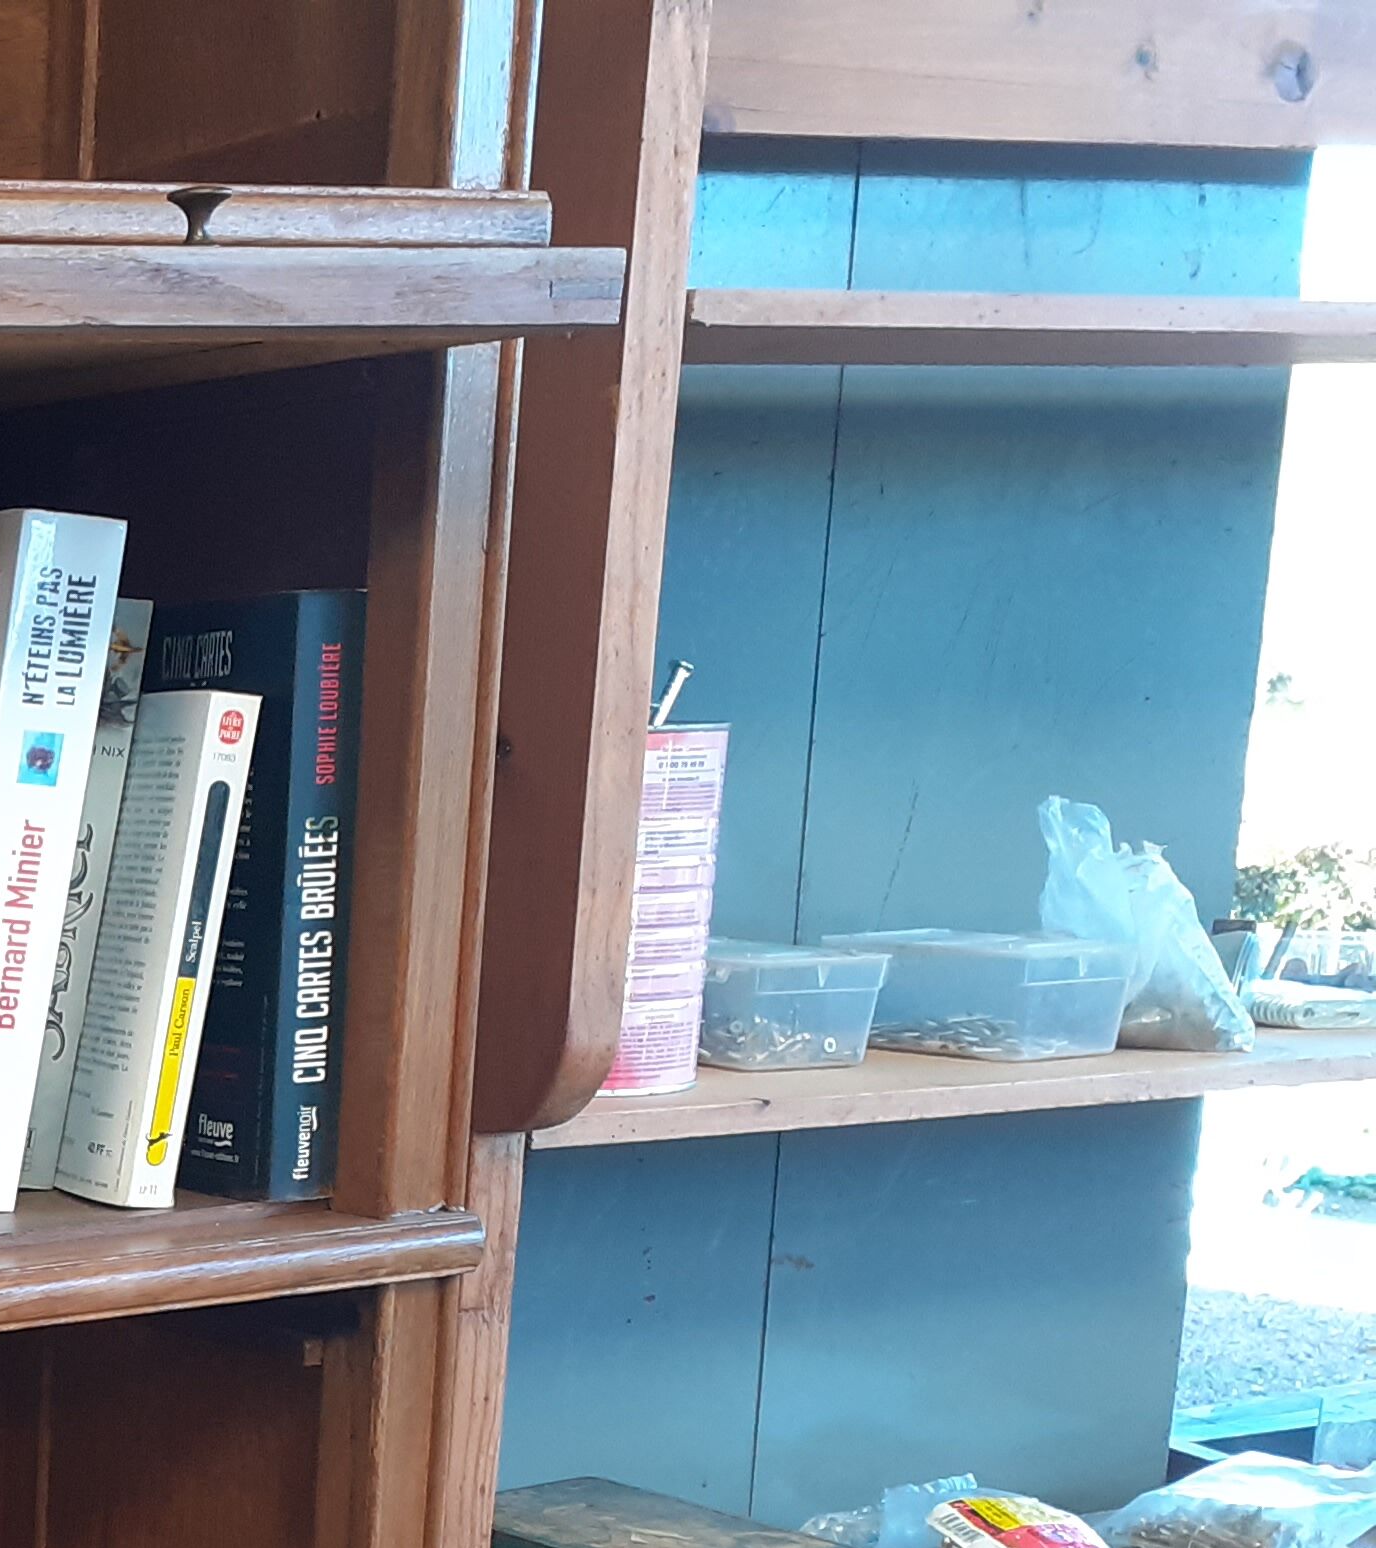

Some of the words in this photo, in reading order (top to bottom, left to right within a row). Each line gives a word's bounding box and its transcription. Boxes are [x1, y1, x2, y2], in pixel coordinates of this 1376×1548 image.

[34, 565, 63, 607] PAS
[55, 574, 97, 678] LUMIÈRE
[195, 631, 232, 678] CARTES
[21, 613, 56, 705] N'ÉTEINS
[317, 642, 341, 721] LOUBIÈRE
[55, 684, 77, 706] LA
[101, 746, 126, 758] NIX
[314, 726, 337, 785] SOPHIE
[5, 818, 45, 909] Minier
[295, 817, 338, 920] BRÛLÉES
[183, 919, 203, 963] Scalpel
[295, 929, 333, 1017] CARTES
[172, 987, 191, 1029] Carson
[167, 1031, 183, 1057] Paul
[291, 1024, 328, 1084] CINQ
[197, 1113, 234, 1139] fleuve
[291, 1104, 318, 1180] fleuvenoir
